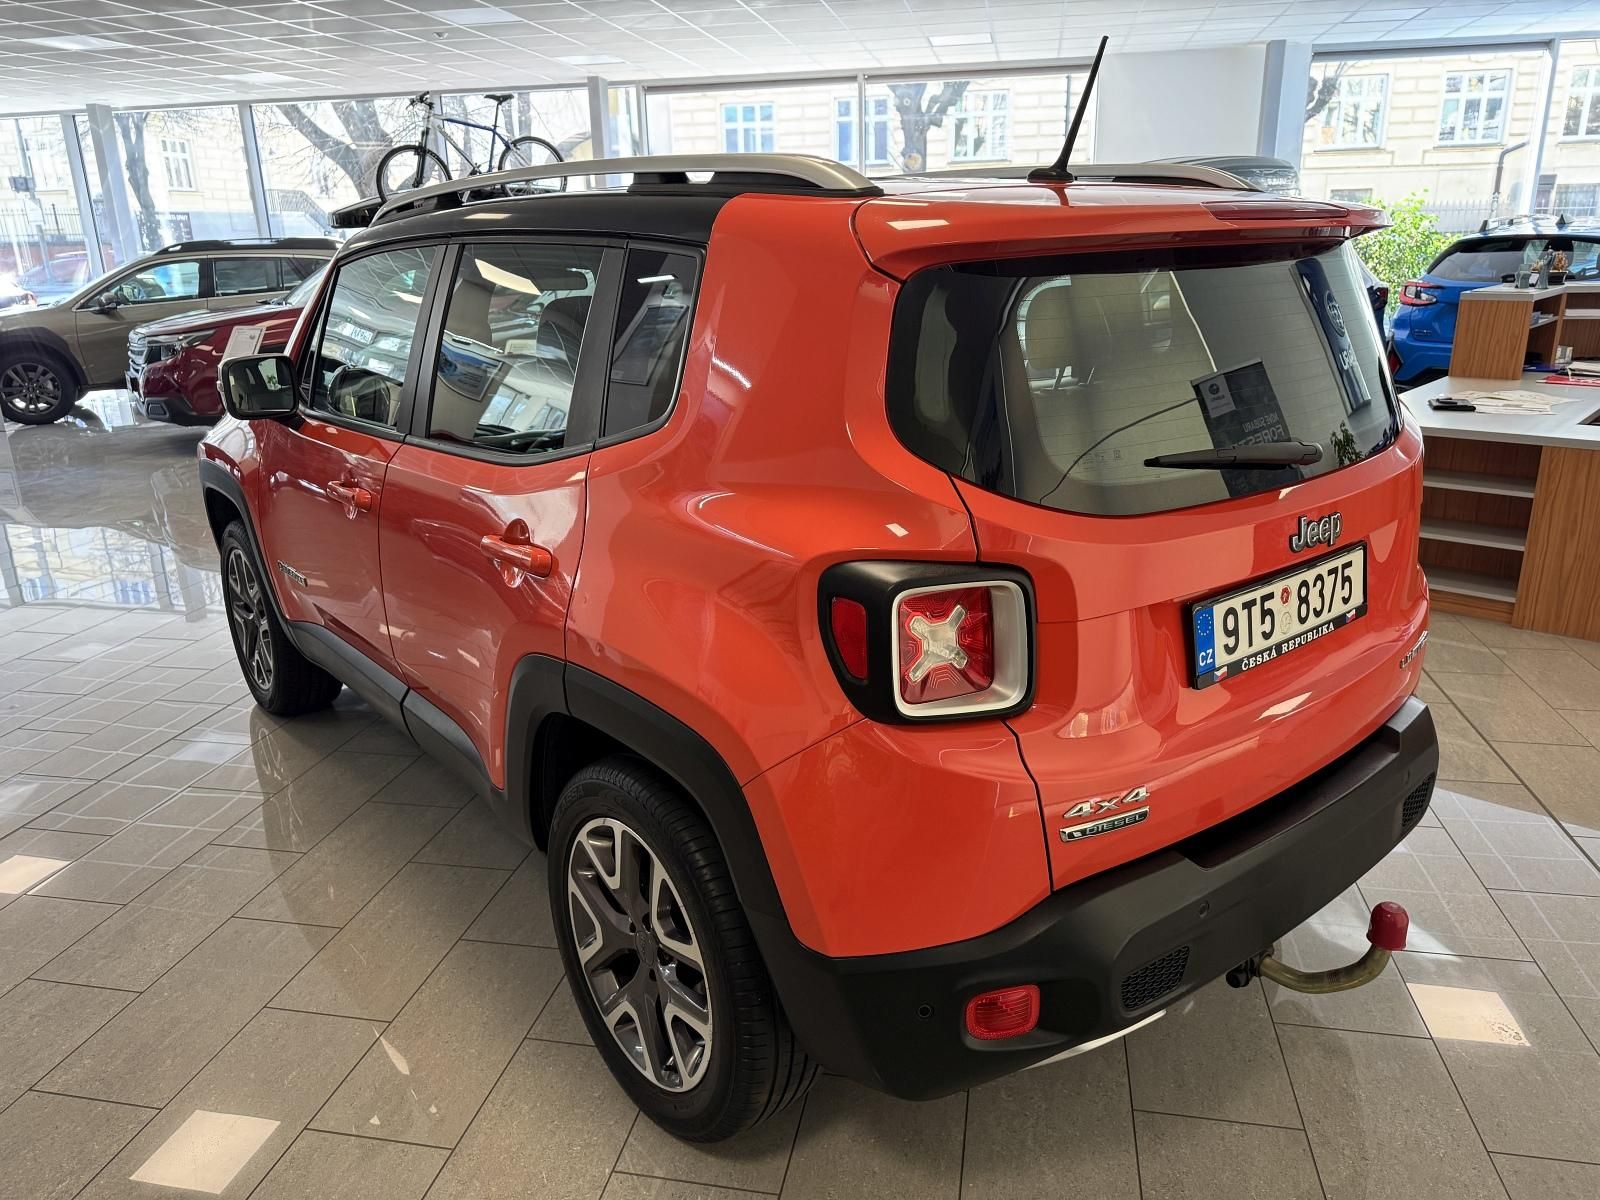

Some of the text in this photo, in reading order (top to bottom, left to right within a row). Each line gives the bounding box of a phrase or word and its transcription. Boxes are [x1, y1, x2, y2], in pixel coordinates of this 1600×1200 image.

[1290, 512, 1342, 553] Jeep
[1222, 560, 1353, 656] 9T5 8375
[1199, 648, 1214, 667] CZ
[1241, 621, 1335, 671] ČESKÁ REPUBLIKA
[1063, 785, 1150, 819] 4x4
[1086, 813, 1145, 835] DIESEL
